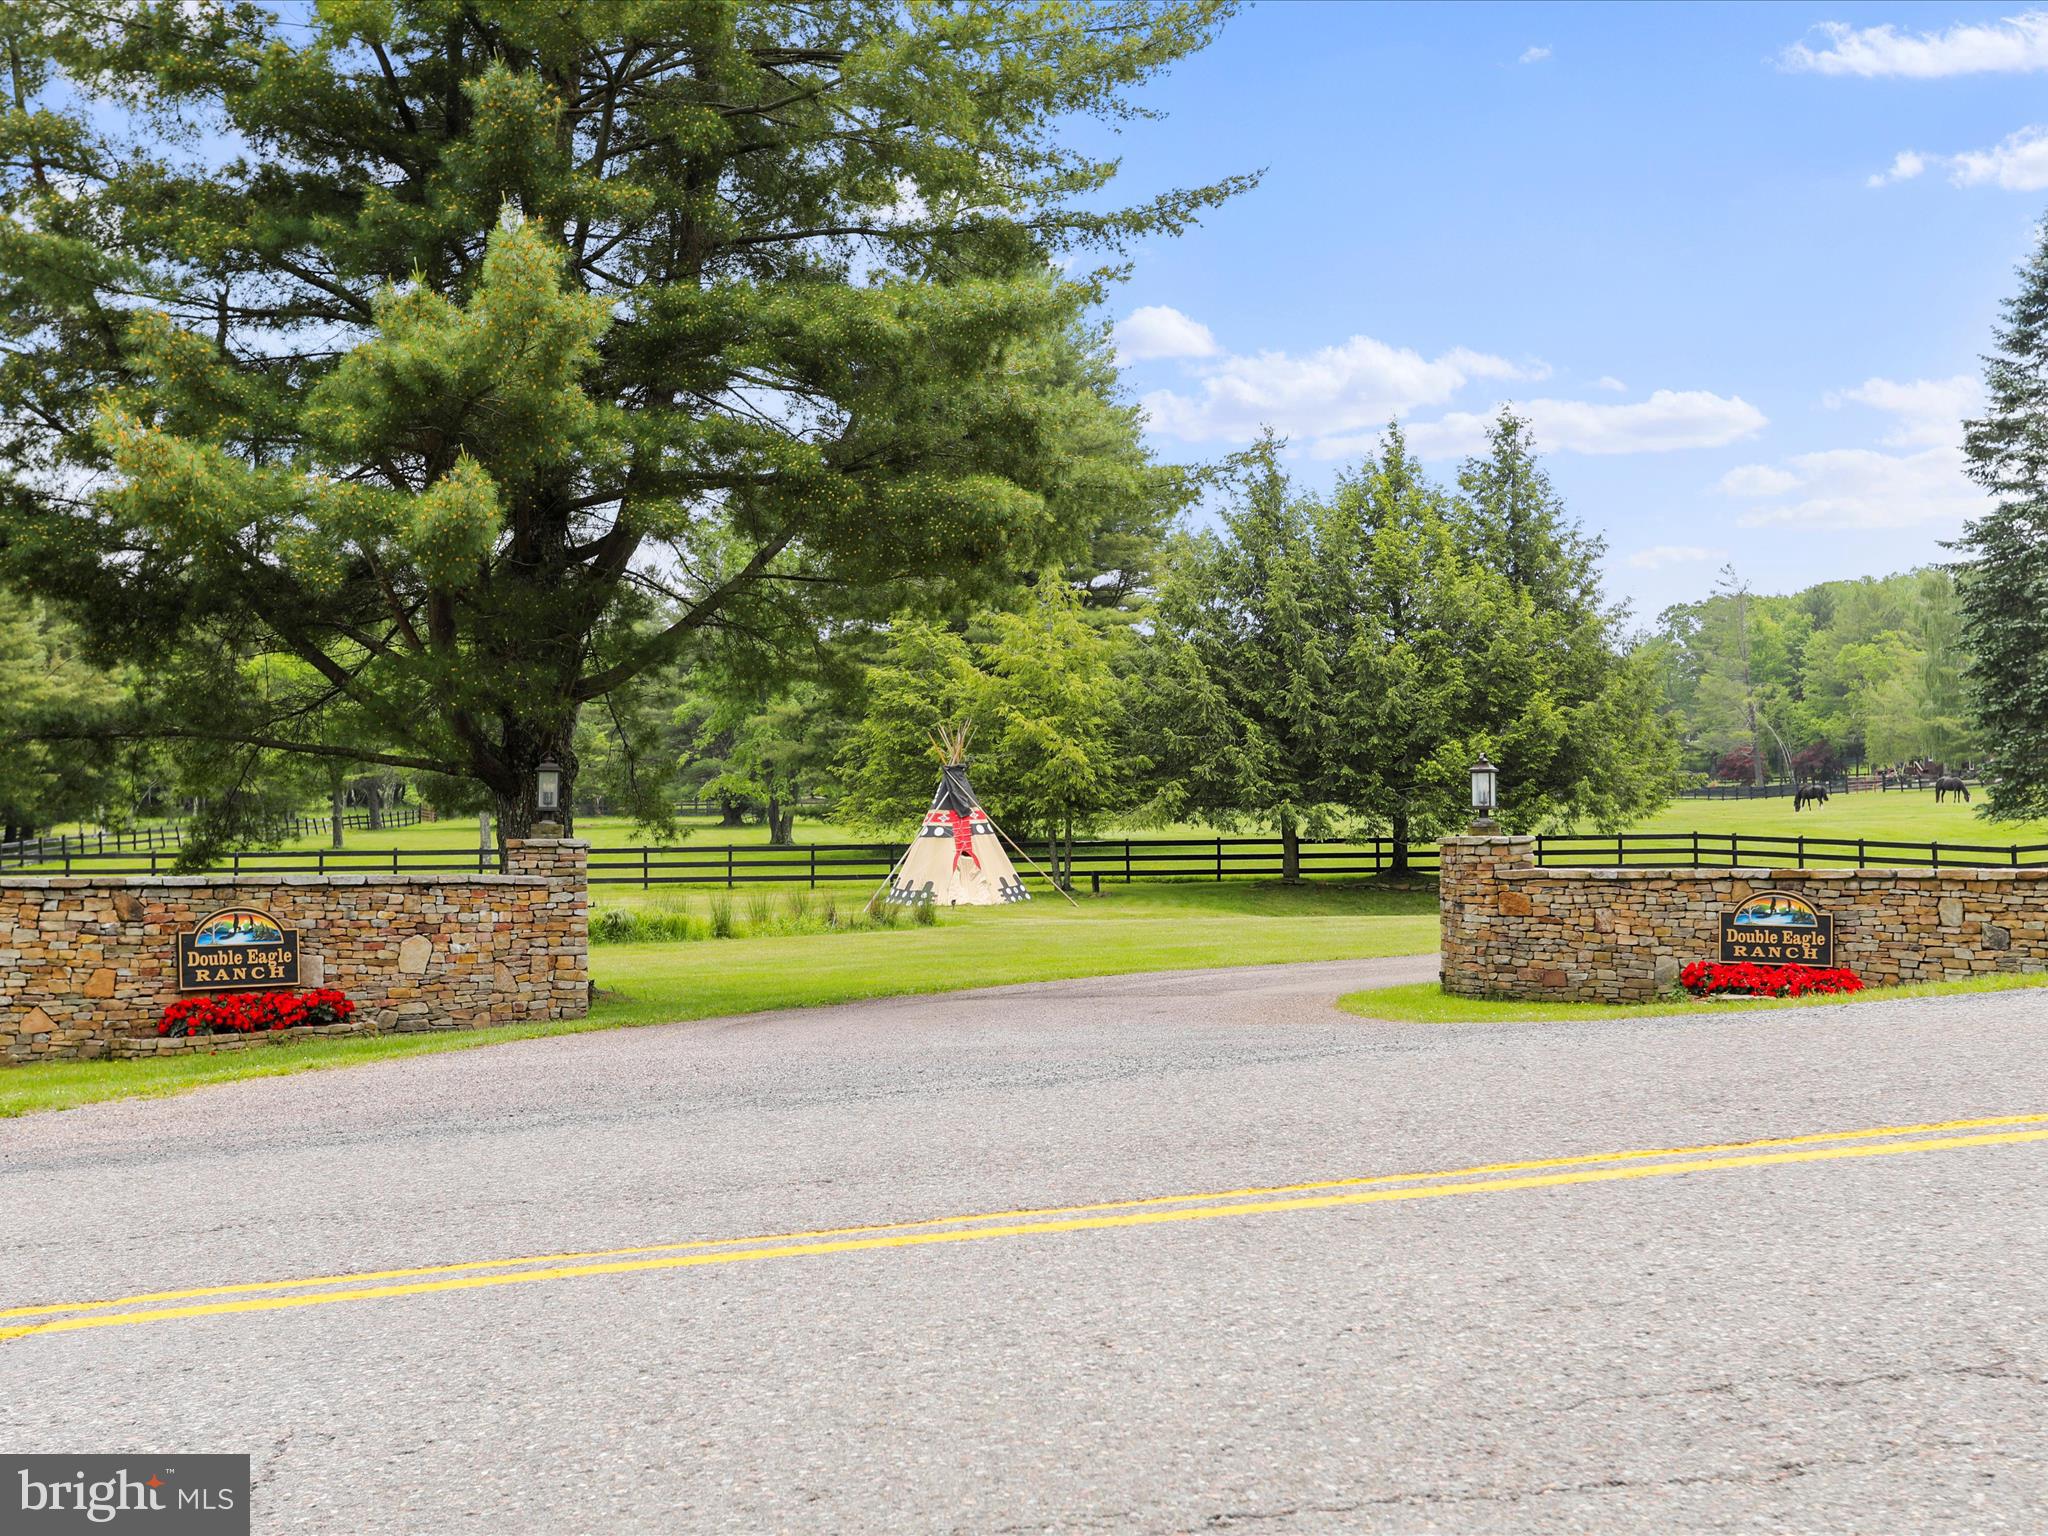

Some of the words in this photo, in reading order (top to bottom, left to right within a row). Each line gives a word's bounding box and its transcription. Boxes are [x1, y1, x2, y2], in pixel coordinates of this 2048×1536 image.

[1726, 928, 1778, 944] Double
[1782, 930, 1825, 949] Eagle
[187, 949, 243, 967] Double
[246, 948, 292, 967] Eagle
[1733, 945, 1818, 960] RANCH
[195, 965, 285, 982] RANCH
